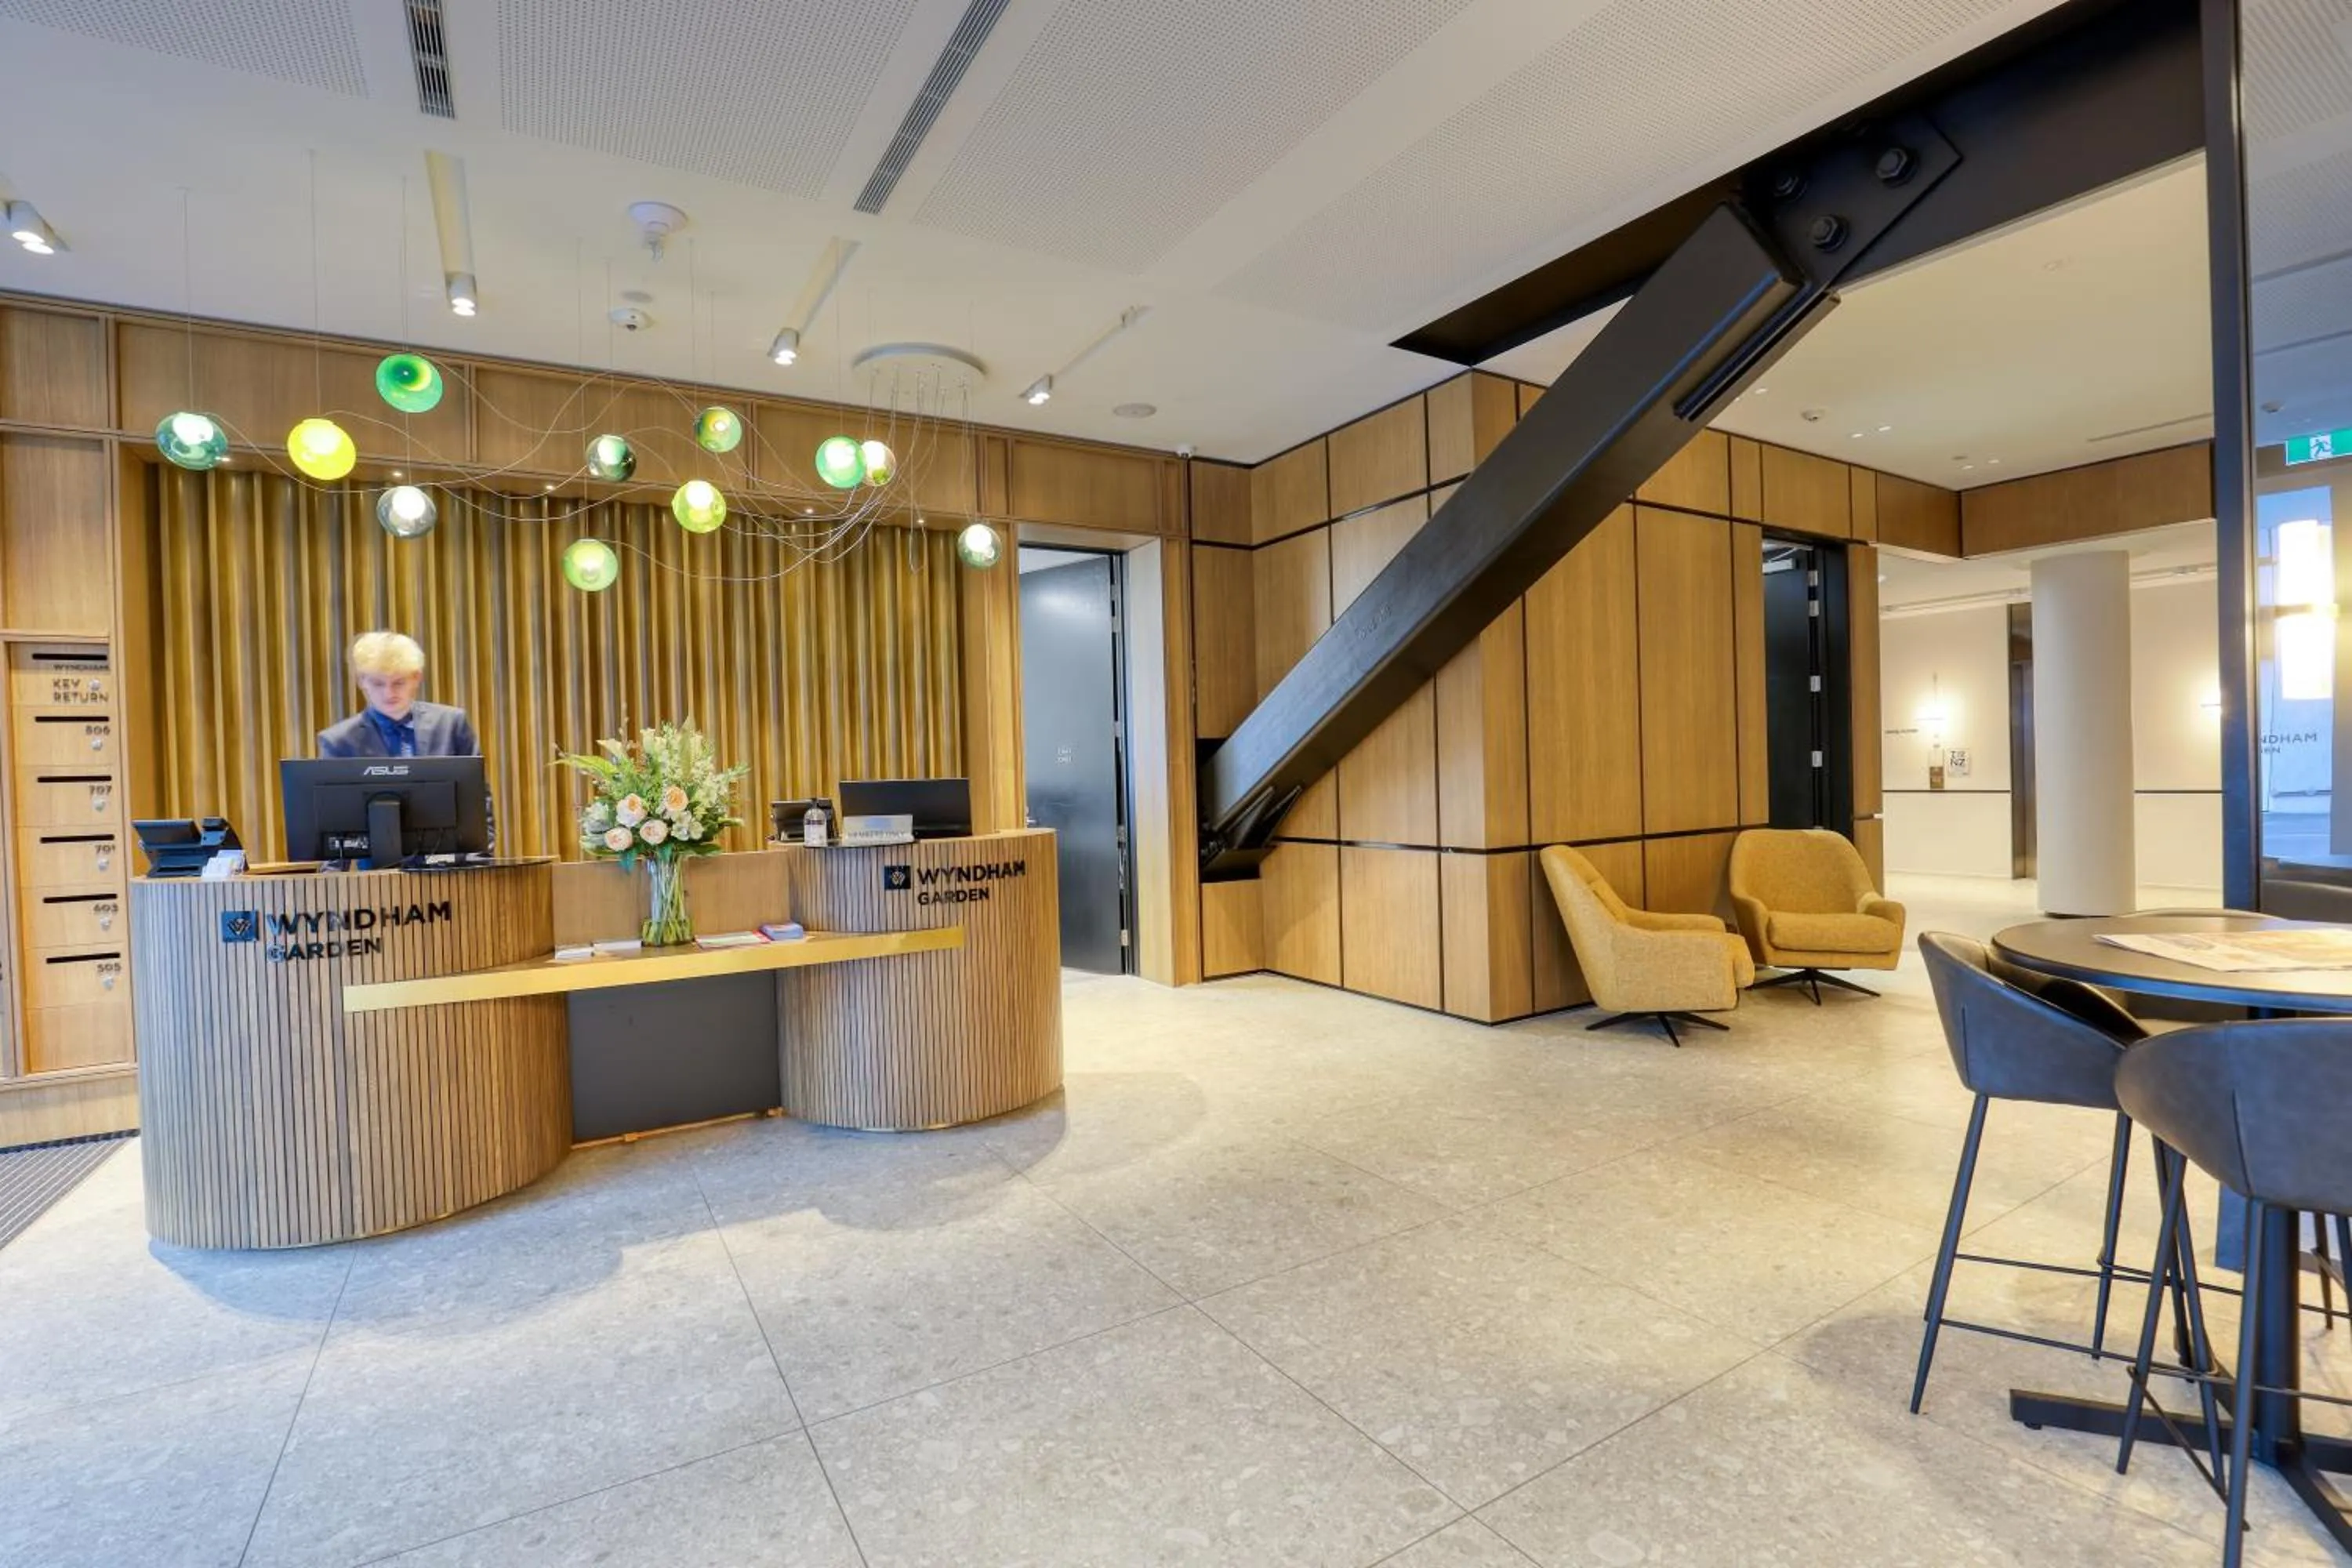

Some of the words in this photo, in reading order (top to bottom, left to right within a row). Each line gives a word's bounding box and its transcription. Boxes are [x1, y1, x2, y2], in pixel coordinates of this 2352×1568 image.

[53, 678, 81, 689] KEY
[53, 691, 110, 703] RETURN
[2259, 733, 2317, 744] NDHAM
[363, 765, 411, 775] ASUS
[916, 860, 1026, 885] WYNDHAM
[917, 887, 990, 906] GARDEN
[266, 900, 452, 935] WYNDHAM
[267, 937, 382, 963] GARDEN
